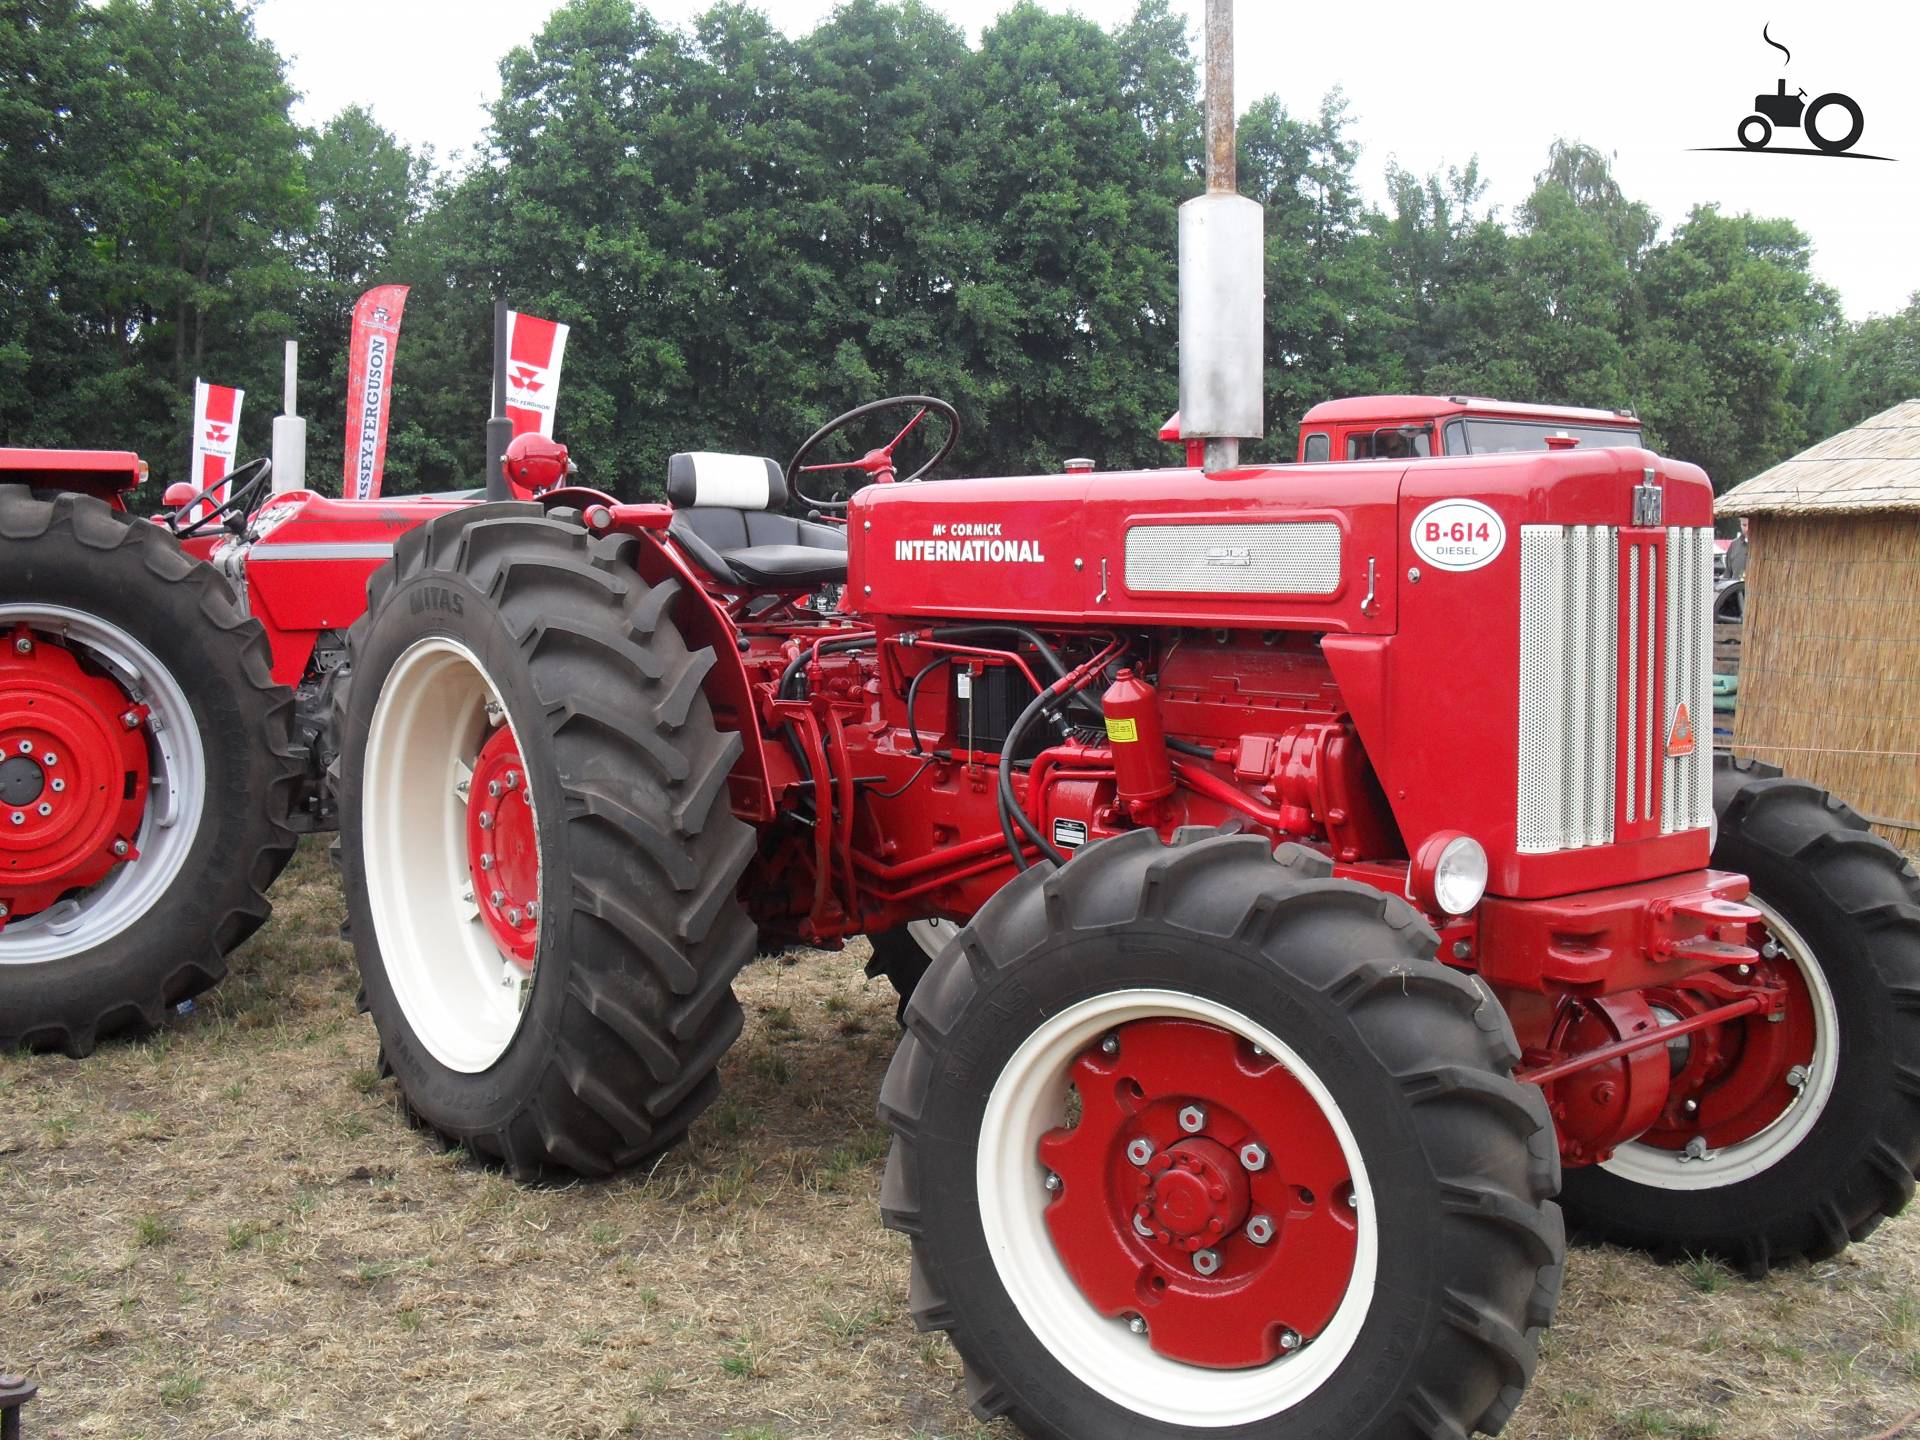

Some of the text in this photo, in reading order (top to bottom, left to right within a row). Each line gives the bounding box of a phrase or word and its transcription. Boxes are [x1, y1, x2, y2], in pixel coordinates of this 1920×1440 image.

[950, 523, 1002, 537] CORMICK
[1425, 522, 1489, 542] B-614
[895, 540, 1045, 563] INTERNATIONAL
[1436, 546, 1478, 556] DIESEL
[408, 586, 464, 618] MITAS
